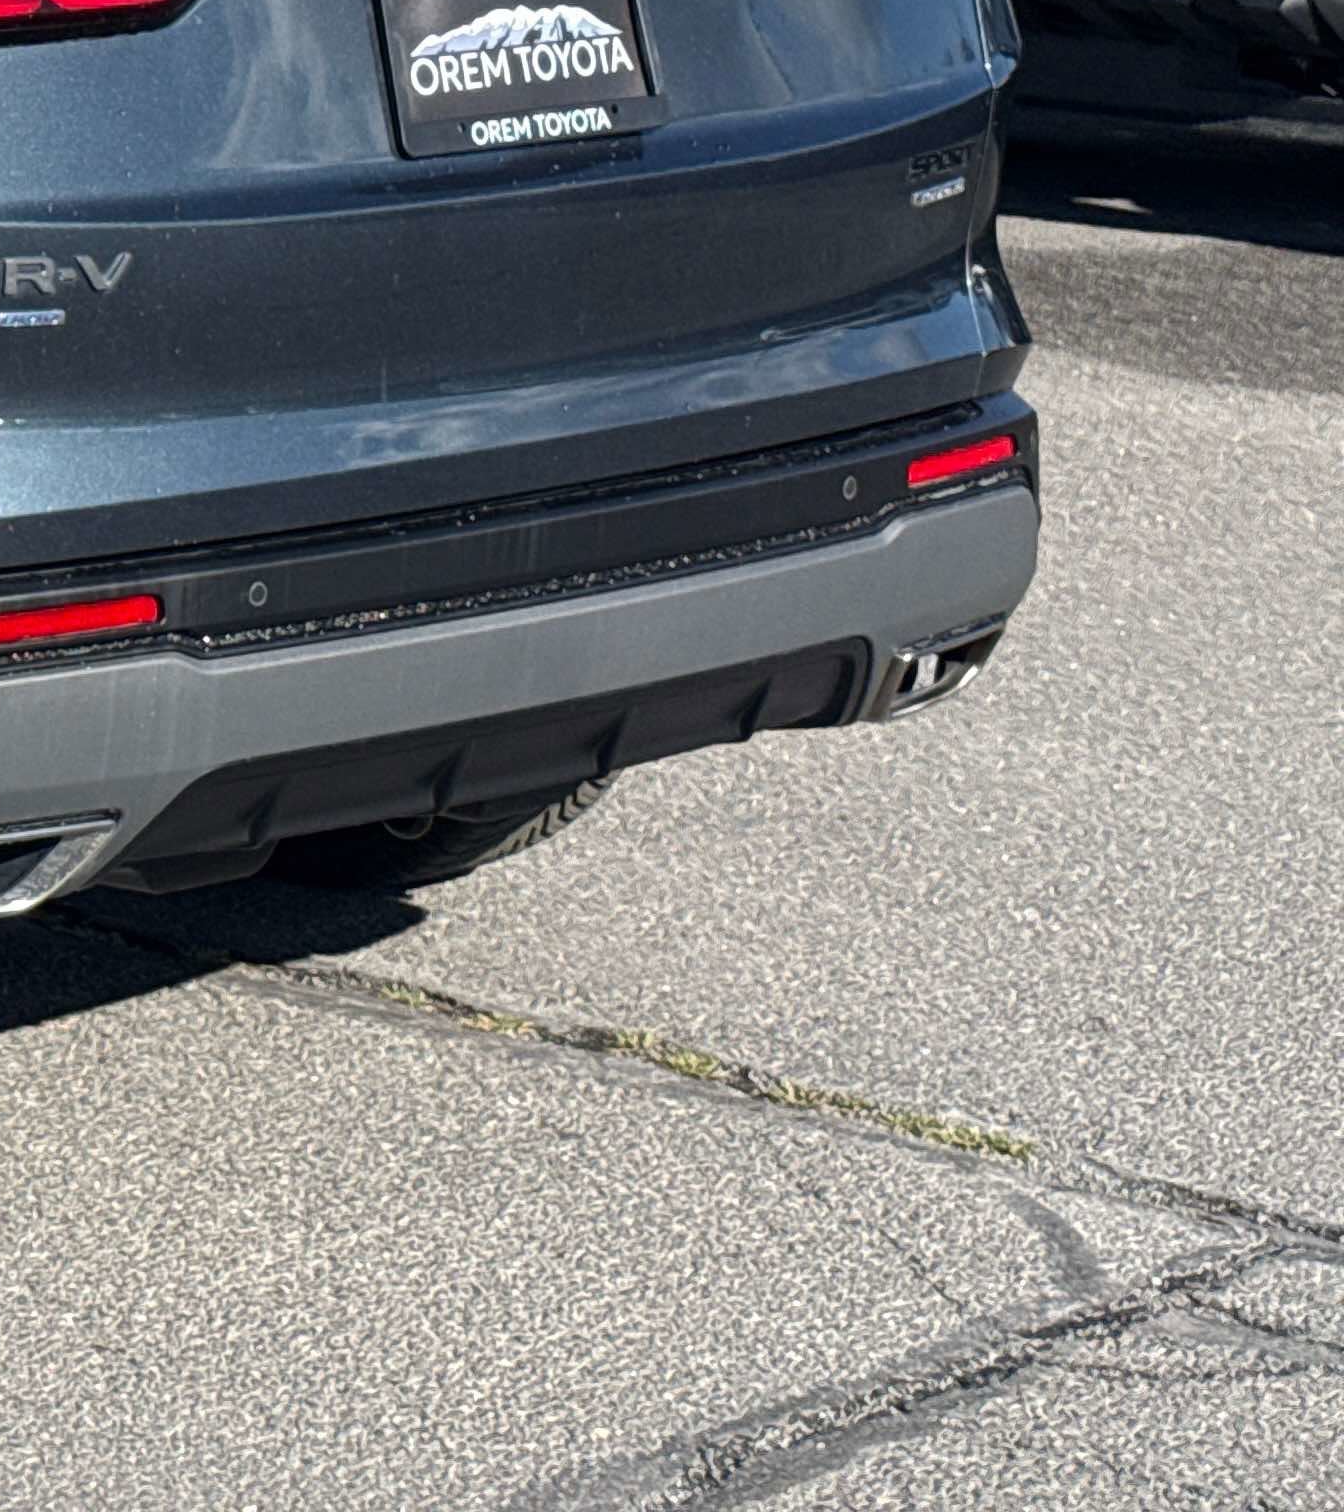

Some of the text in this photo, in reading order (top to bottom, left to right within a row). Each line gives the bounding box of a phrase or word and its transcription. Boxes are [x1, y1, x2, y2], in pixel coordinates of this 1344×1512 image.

[410, 36, 635, 96] OREM TOYOTA
[471, 106, 612, 146] OREM TOYOTA
